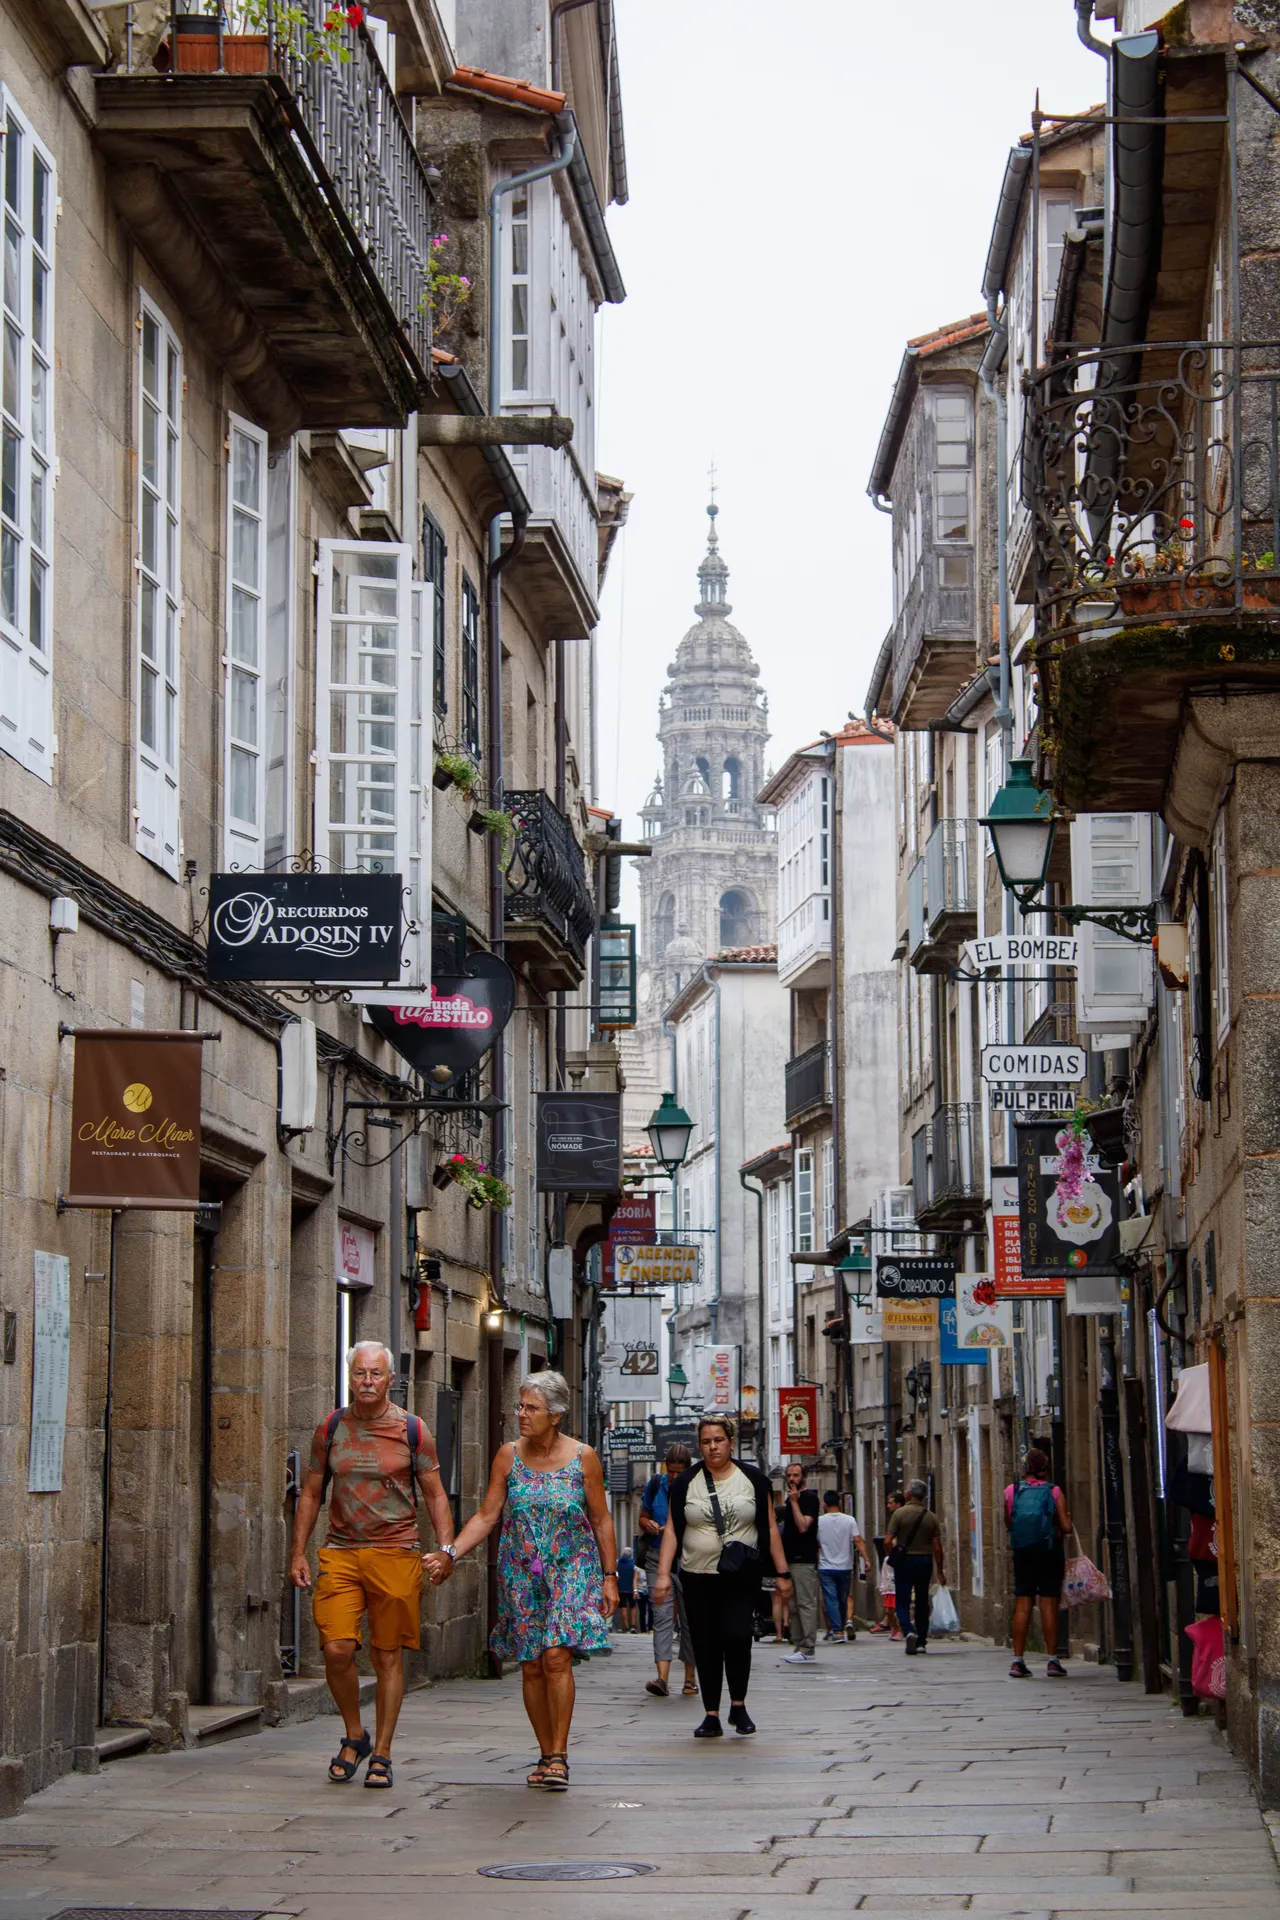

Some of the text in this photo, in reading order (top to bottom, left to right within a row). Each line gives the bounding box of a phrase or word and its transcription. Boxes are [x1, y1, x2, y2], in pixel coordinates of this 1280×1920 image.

[214, 892, 394, 948] PADOSIN IV
[277, 906, 369, 918] RECUERDOS
[975, 941, 1002, 963] EL
[424, 998, 470, 1011] unda
[432, 1010, 489, 1024] ESTILO
[989, 1054, 1079, 1074] COMIDAS
[993, 1091, 1074, 1110] PULPERIA
[78, 1115, 136, 1148] Marie
[1026, 1139, 1059, 1265] TU RINCON DULCE DE
[636, 1247, 696, 1260] AGENCIA
[620, 1264, 693, 1281] FONSECA
[900, 1261, 955, 1269] RECUERDOS
[899, 1278, 955, 1294] OBRADOIRO 4
[887, 1313, 933, 1323] O'FLANAGAN'S
[624, 1351, 656, 1374] 42
[715, 1391, 729, 1405] EL
